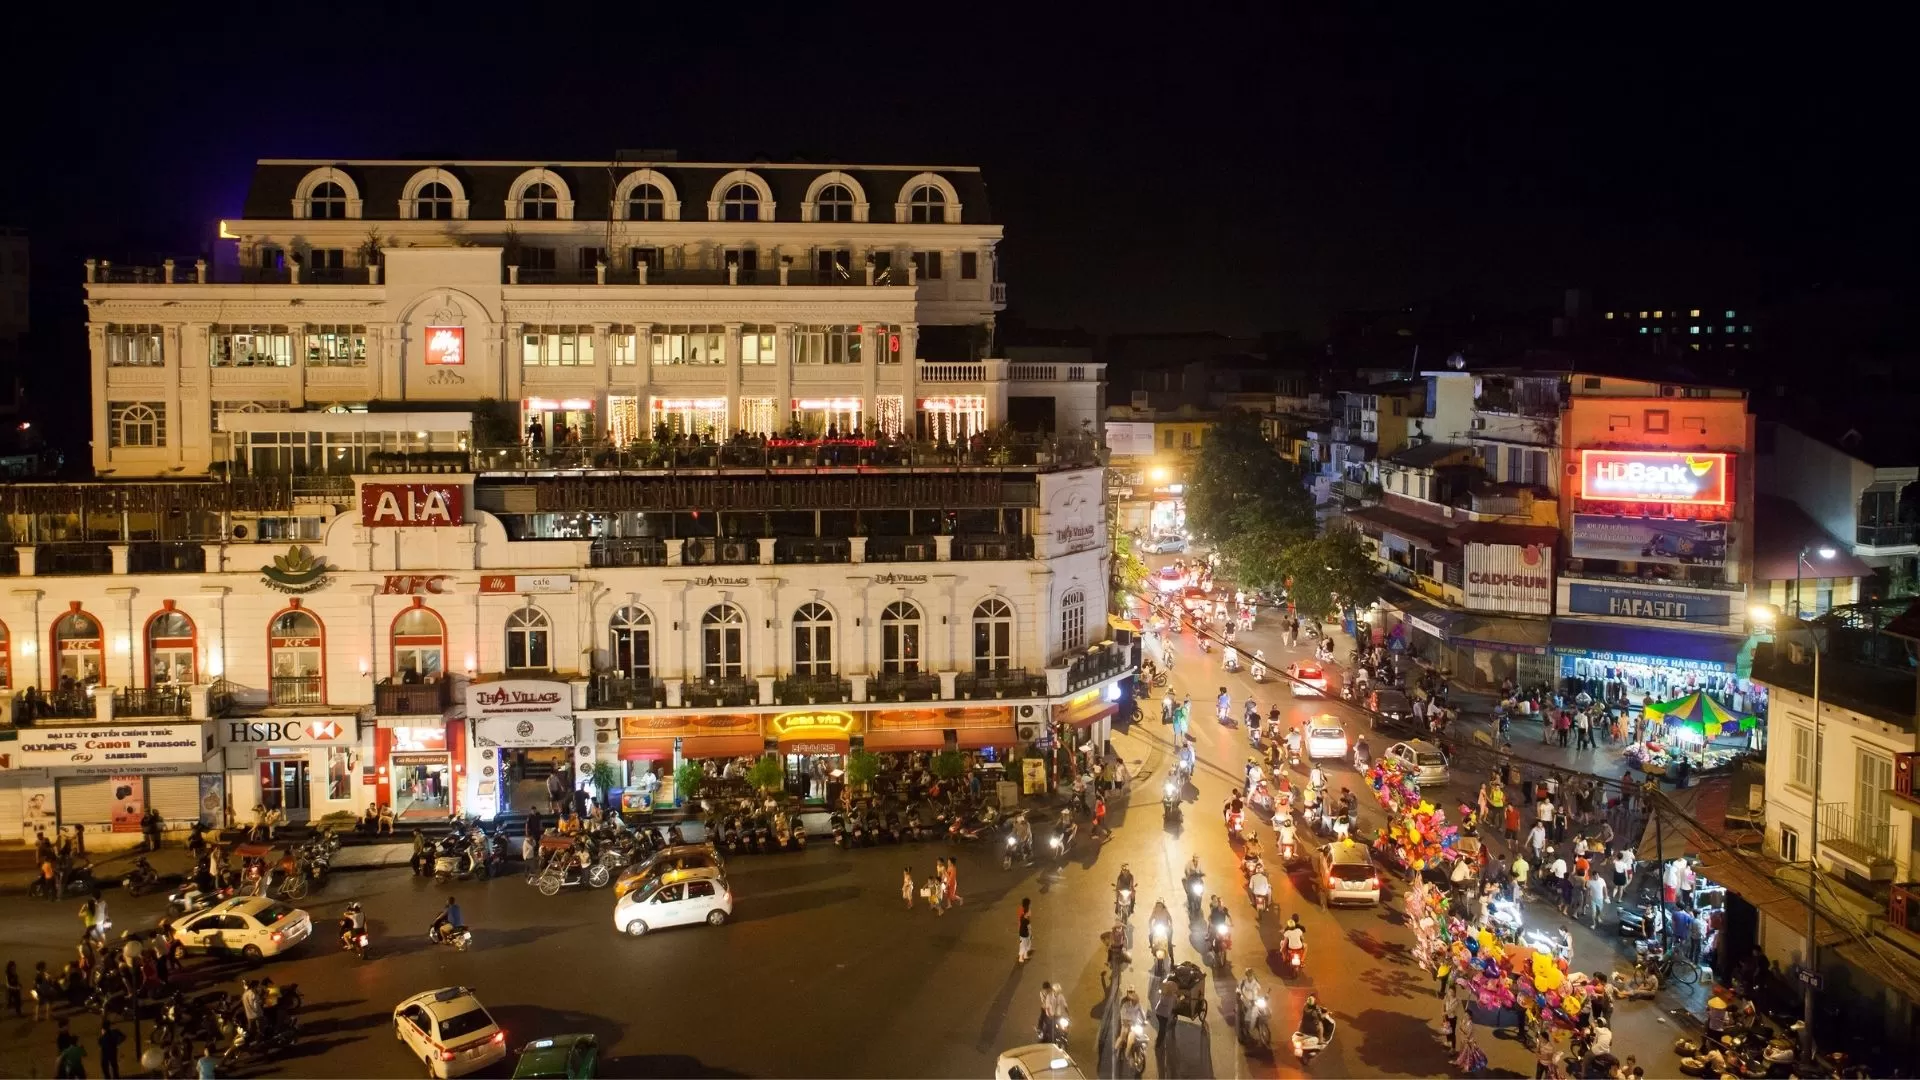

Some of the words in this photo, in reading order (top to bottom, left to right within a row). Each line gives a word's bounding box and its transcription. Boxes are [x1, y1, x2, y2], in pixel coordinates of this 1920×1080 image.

[1597, 462, 1687, 483] HDBank
[373, 490, 450, 521] AIA
[382, 575, 445, 595] KFC
[490, 577, 506, 590] illy
[533, 577, 550, 586] café
[718, 577, 748, 586] VILLAGE
[897, 574, 928, 583] VILLAGE
[1468, 572, 1547, 589] CADI-SUN
[1610, 597, 1687, 620] HAFASCO
[66, 640, 93, 649] KFC
[284, 638, 310, 647] KFC
[1554, 647, 1587, 655] HAFASCO
[1591, 650, 1614, 661] THỜI
[1616, 655, 1648, 664] TRANG
[1650, 657, 1668, 666] 102
[1671, 658, 1699, 669] HÀNG
[511, 691, 561, 704] VILLAGE
[229, 721, 301, 742] HSBC
[22, 742, 78, 751] OLYMPUS
[85, 740, 131, 749] Canon
[137, 739, 197, 748] Panasonic
[105, 752, 148, 760] SAMSUNG
[419, 755, 447, 764] Kentucky
